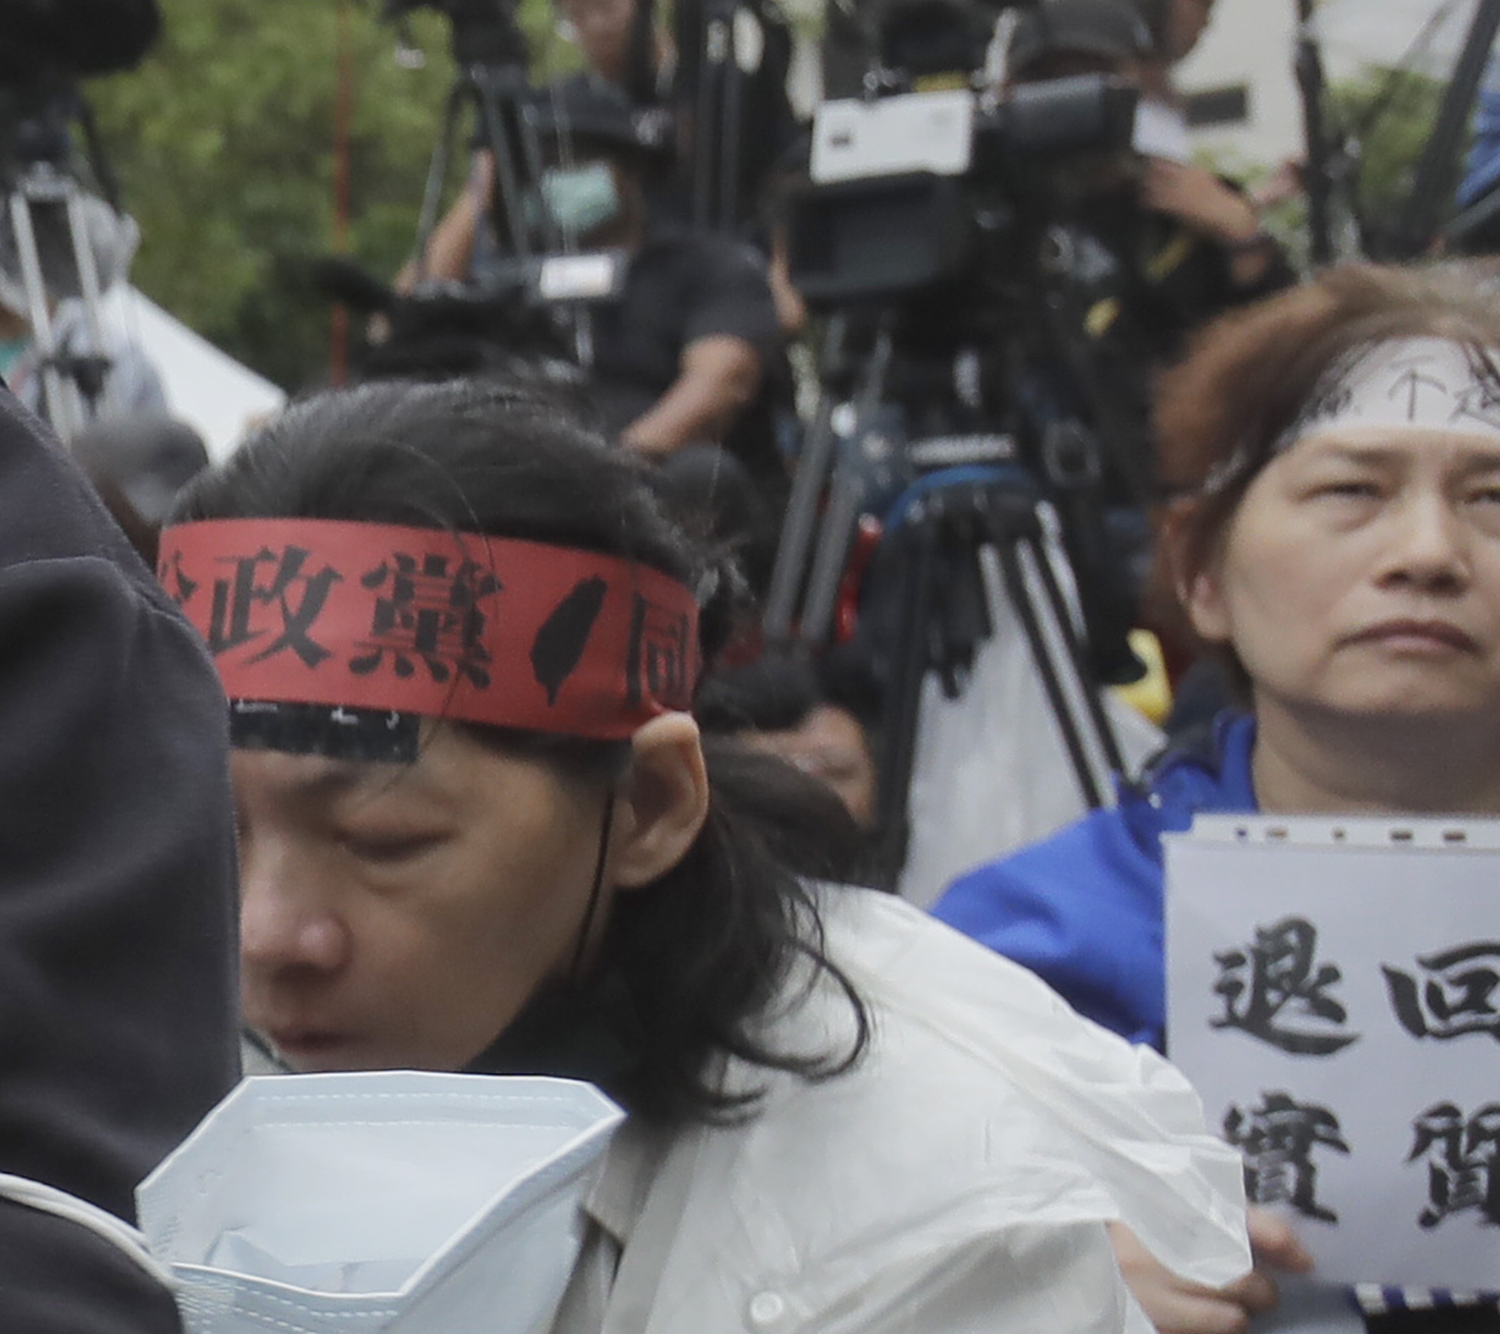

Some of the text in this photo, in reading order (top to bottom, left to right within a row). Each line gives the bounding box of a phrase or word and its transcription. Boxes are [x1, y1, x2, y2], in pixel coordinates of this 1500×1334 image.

[164, 544, 504, 690] 政黨
[1209, 916, 1500, 1055] 退回
[1223, 1089, 1500, 1229] 實質
